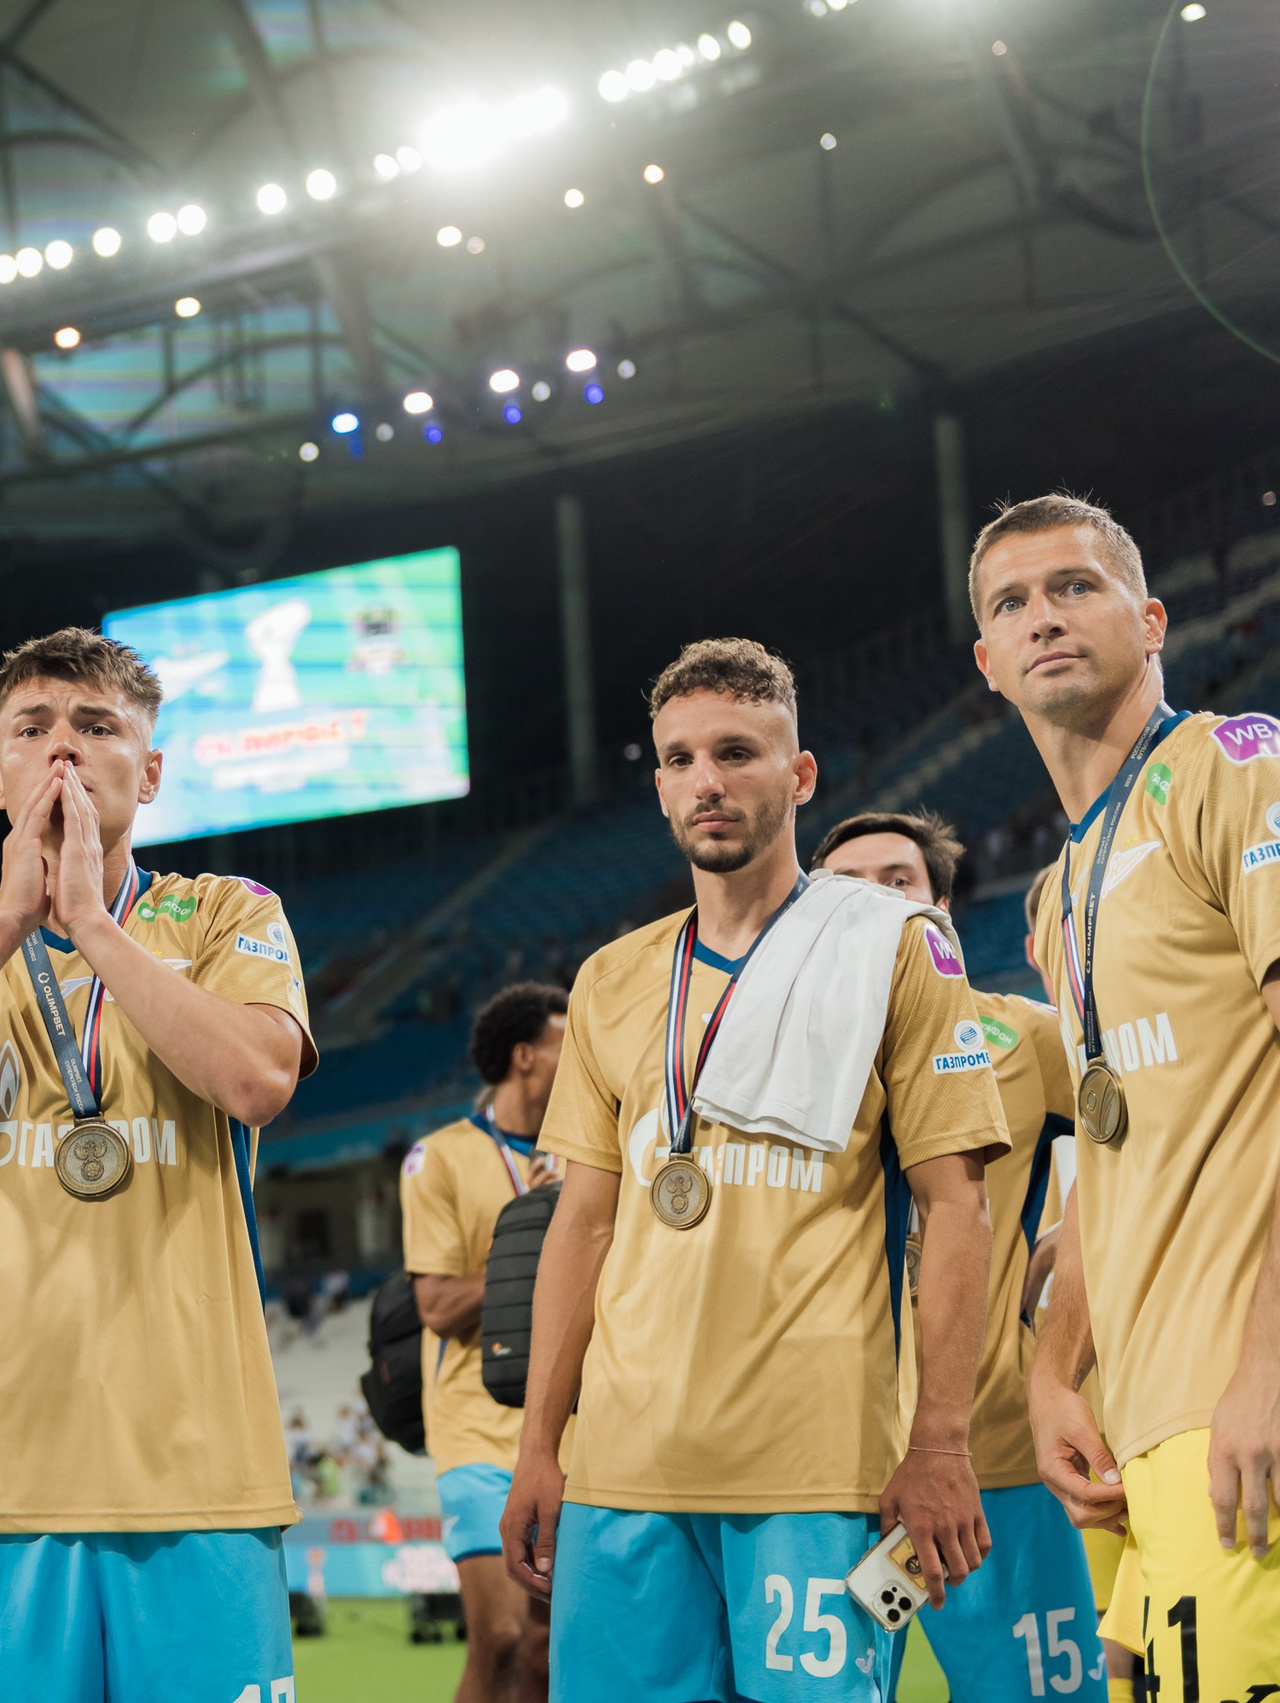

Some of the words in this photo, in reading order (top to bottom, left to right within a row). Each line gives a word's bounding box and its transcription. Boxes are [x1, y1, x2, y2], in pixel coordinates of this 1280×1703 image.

[1225, 723, 1273, 746] WB
[1087, 893, 1096, 956] OLIMPBET
[43, 985, 66, 1037] OLIMPBET
[764, 1574, 847, 1678] 25
[1012, 1607, 1083, 1697] 15
